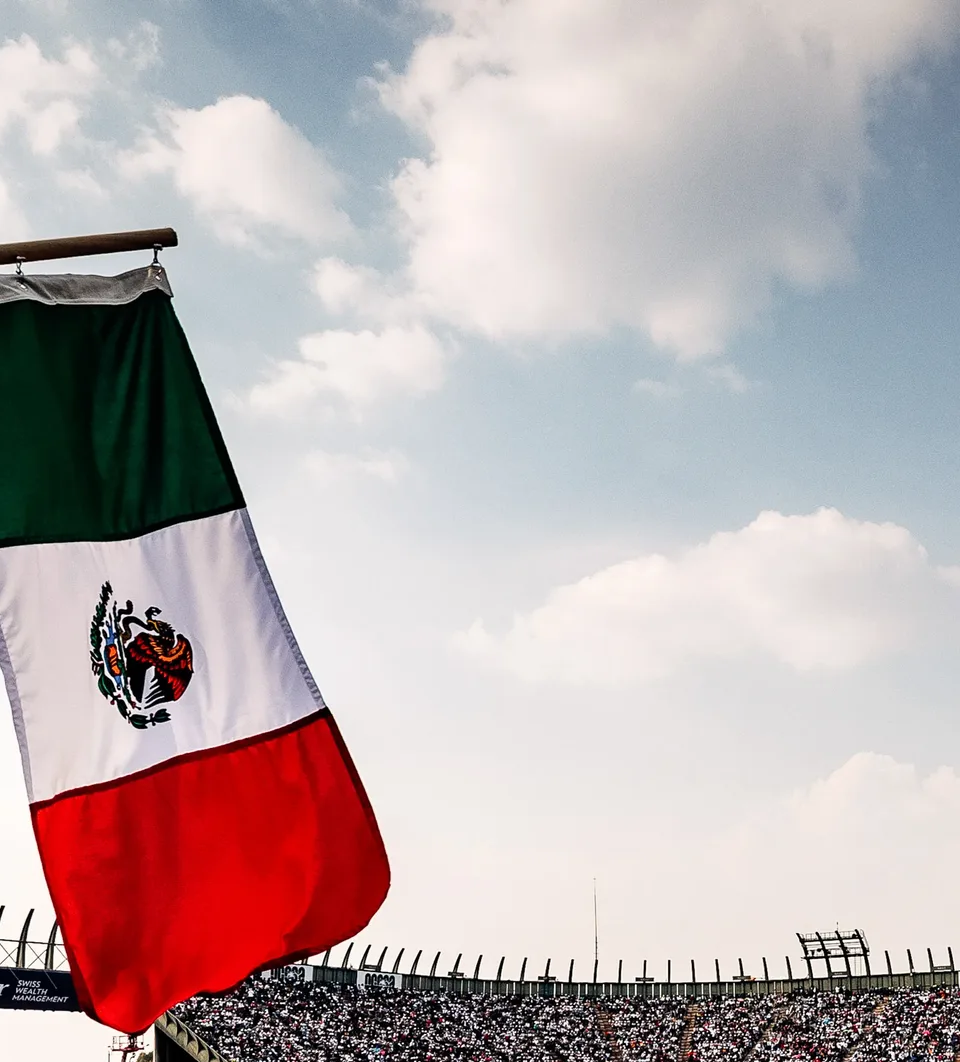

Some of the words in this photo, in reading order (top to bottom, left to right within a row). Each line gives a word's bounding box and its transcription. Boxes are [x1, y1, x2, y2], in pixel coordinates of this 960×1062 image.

[17, 980, 41, 988] SWISS
[15, 987, 48, 995] WEALTH
[12, 994, 69, 1003] MANAGEMENT
